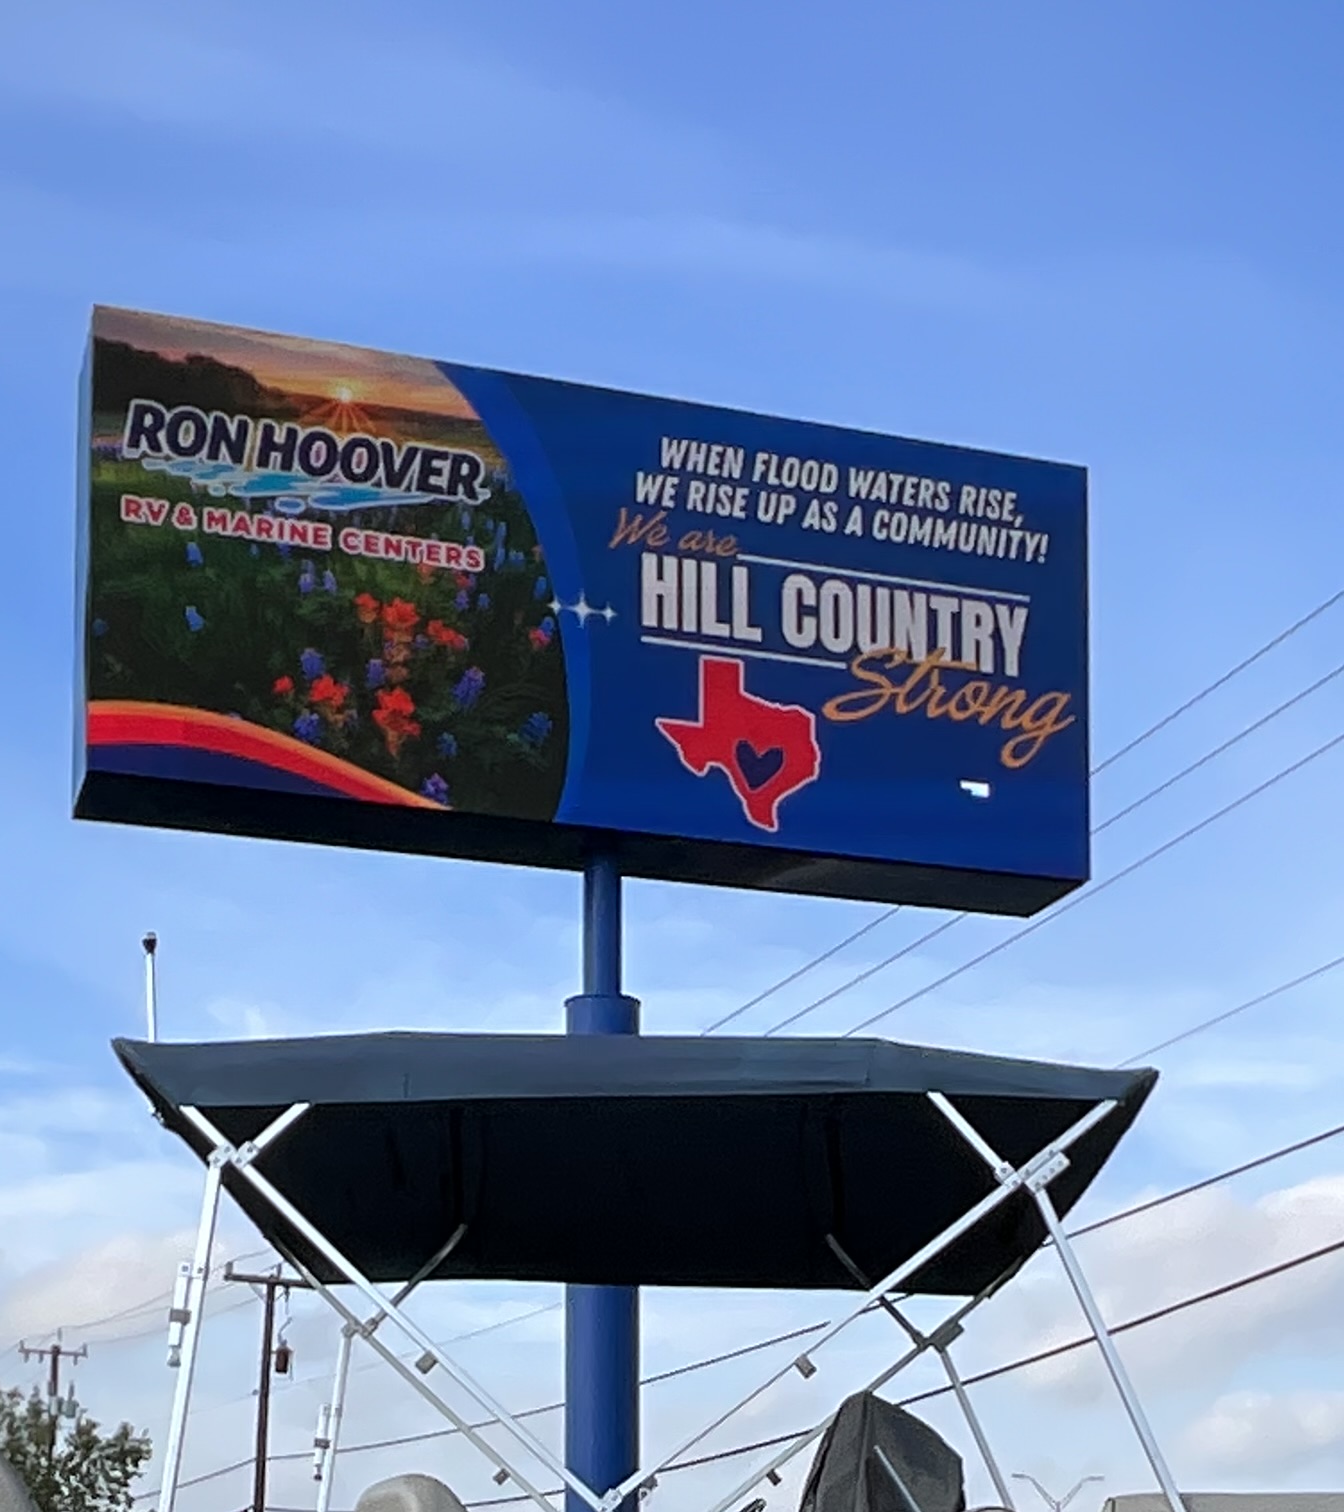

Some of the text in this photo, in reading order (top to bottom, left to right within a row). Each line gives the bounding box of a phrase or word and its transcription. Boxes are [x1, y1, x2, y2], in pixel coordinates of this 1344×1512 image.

[125, 401, 488, 500] RON HOOVER
[661, 437, 1023, 528] WHEN FLOOD WATERS RISE,
[123, 498, 486, 571] RV & MARINE CENTERS
[607, 507, 740, 557] We are
[636, 471, 1049, 564] WE RISE UP AS A COMMUNITY!
[641, 552, 1030, 677] HILL COUNTRY
[821, 646, 1077, 769] Strong
